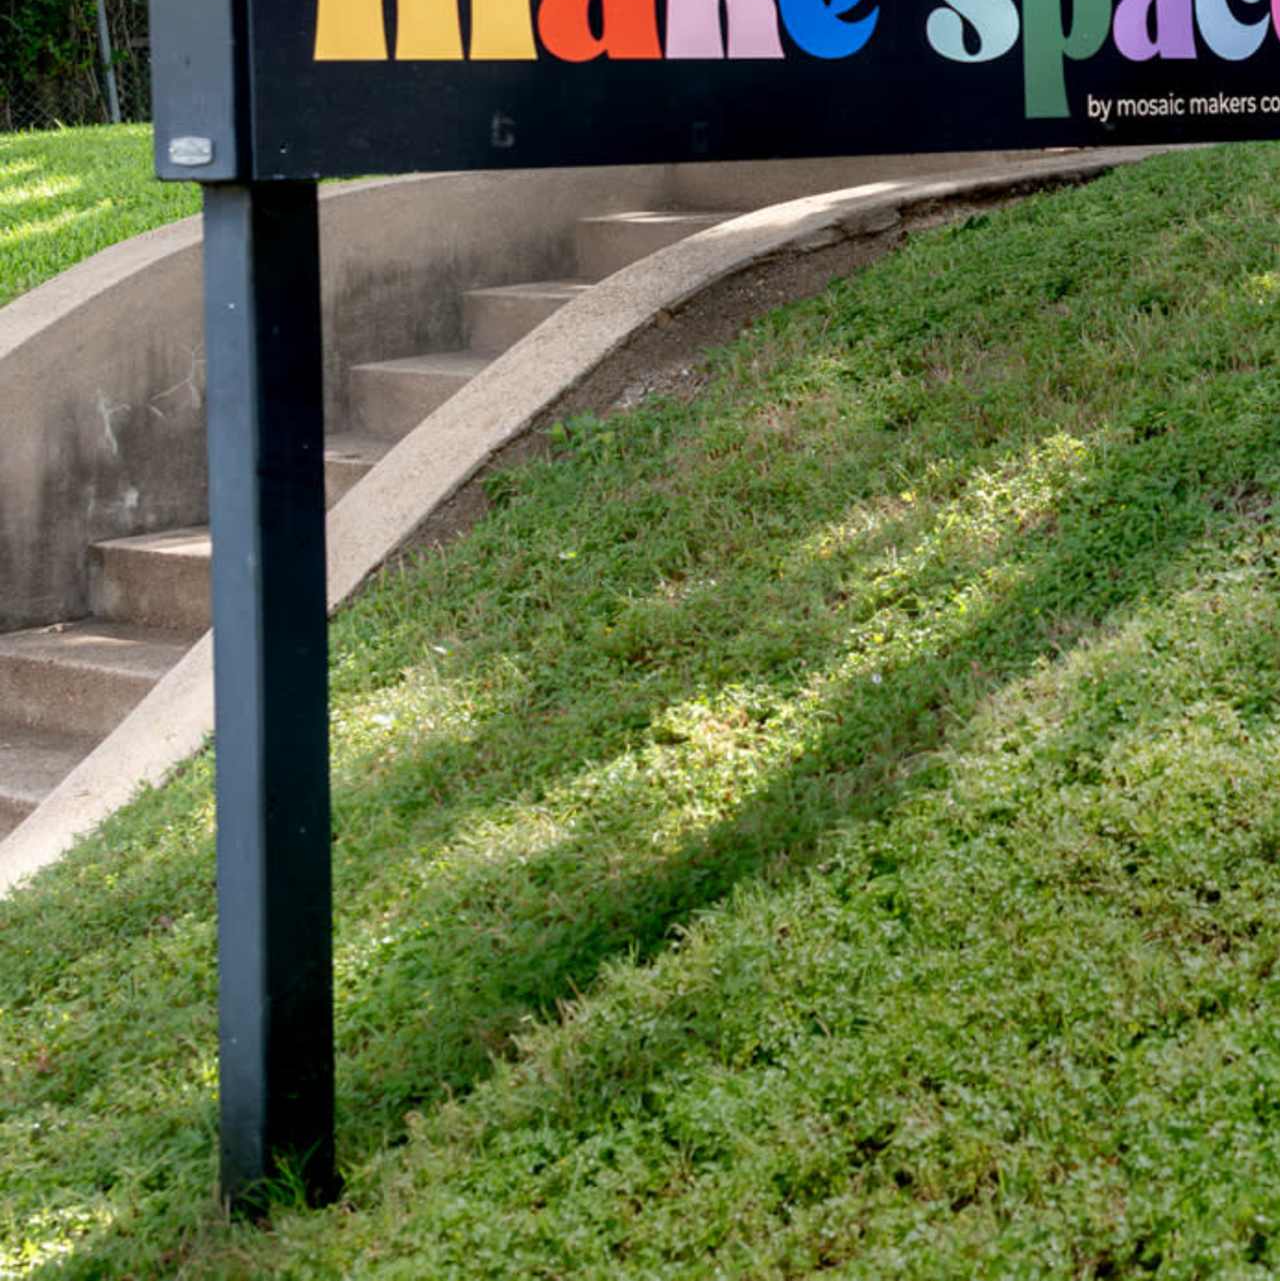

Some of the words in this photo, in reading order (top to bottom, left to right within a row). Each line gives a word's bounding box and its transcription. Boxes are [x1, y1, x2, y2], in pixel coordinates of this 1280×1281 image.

[1087, 94, 1112, 122] by
[1117, 93, 1185, 117] mosaic
[1189, 92, 1257, 115] makers
